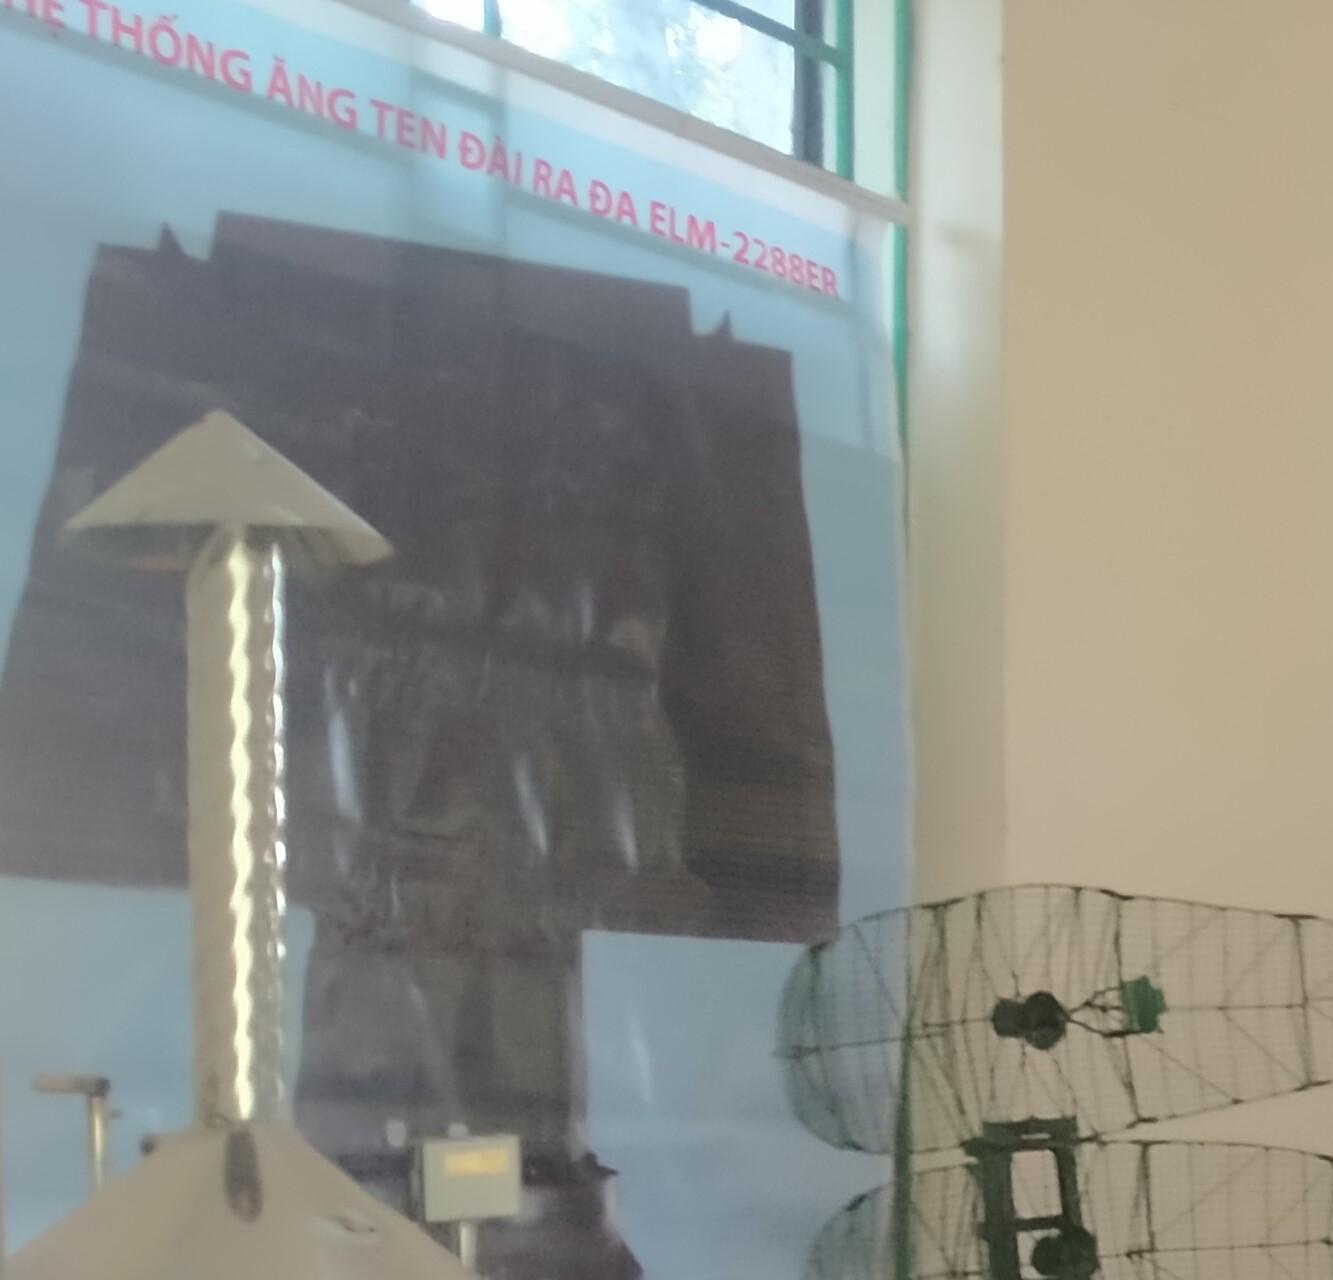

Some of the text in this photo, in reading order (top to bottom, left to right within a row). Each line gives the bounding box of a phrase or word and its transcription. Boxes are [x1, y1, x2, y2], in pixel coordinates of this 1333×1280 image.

[79, 0, 253, 93] THỐNG
[266, 55, 357, 130] ĂNG
[369, 98, 447, 160] TEN
[533, 158, 578, 207] RA
[588, 179, 638, 228] ĐA
[650, 200, 839, 300] ELM-2288ER
